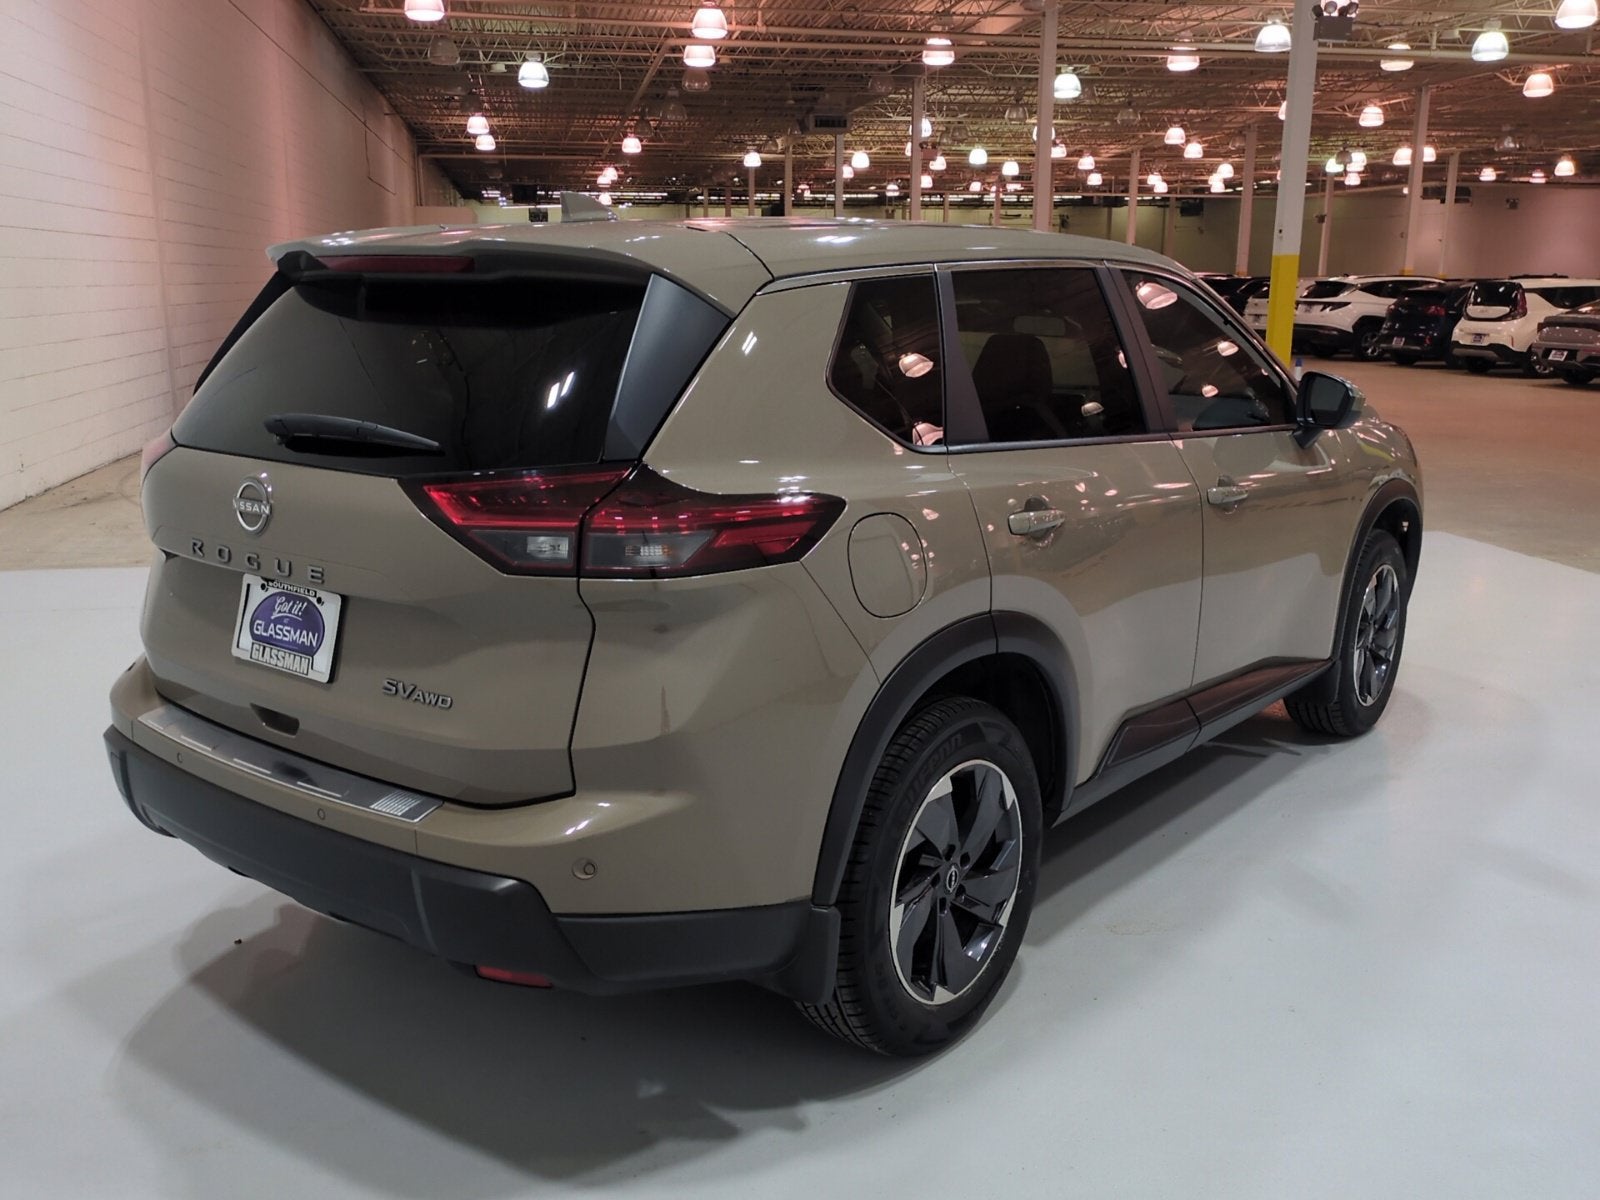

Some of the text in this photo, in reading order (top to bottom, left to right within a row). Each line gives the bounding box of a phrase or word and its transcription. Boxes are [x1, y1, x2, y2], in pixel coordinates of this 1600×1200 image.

[192, 538, 325, 585] ROGUE
[273, 596, 293, 617] Got
[253, 620, 318, 648] GLASSMAN
[251, 643, 309, 675] GLASSMAN
